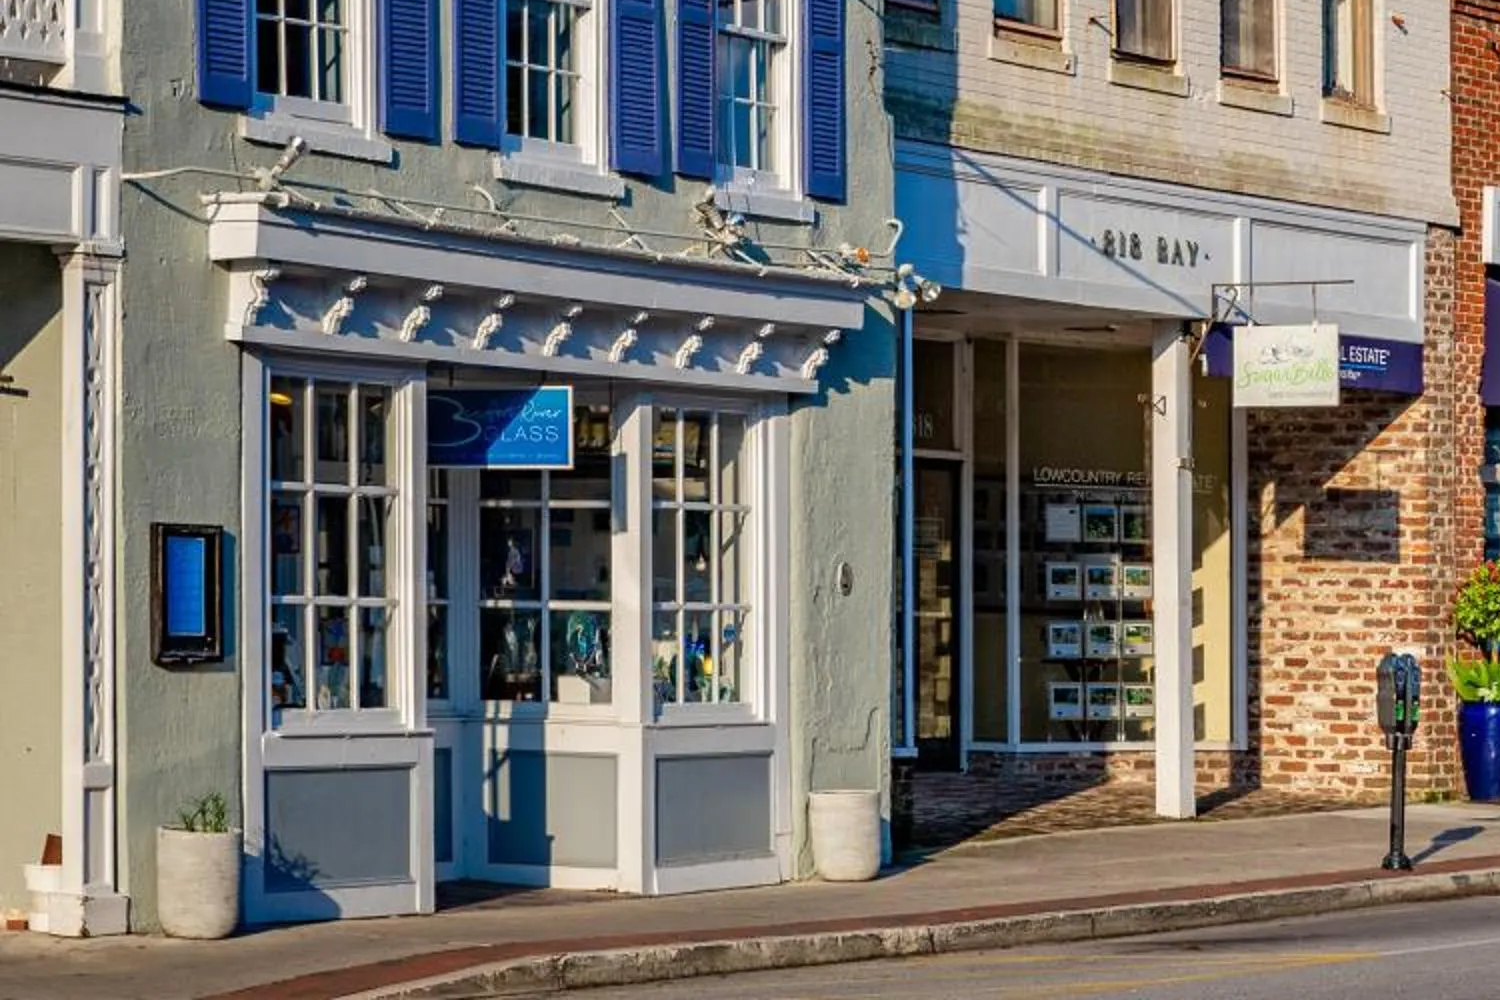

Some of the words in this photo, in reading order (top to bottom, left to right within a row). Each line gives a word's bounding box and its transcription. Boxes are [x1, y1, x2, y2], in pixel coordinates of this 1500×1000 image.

[1103, 229, 1143, 261] 818
[1157, 235, 1199, 268] BAY
[484, 425, 560, 442] GLASS
[1033, 467, 1121, 484] LOWCOUNTRY
